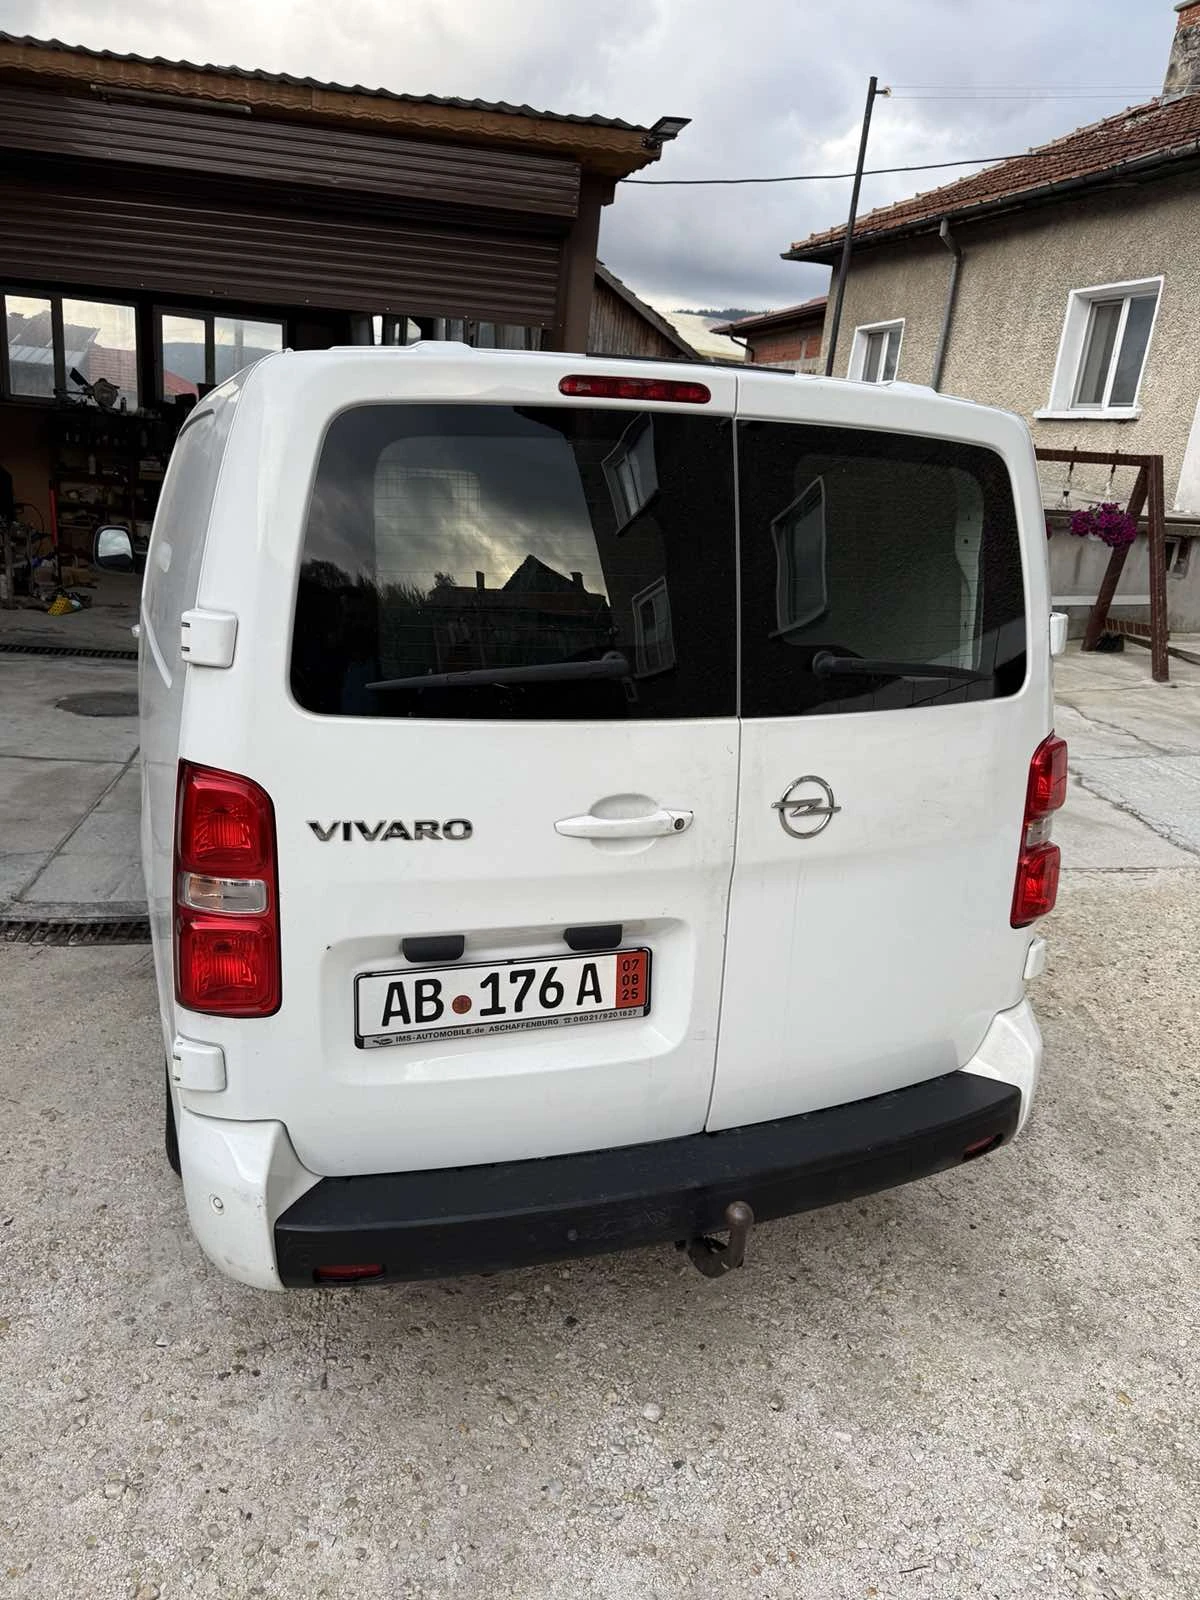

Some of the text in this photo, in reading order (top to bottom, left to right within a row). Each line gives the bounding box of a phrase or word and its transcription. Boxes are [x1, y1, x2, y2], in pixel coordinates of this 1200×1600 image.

[307, 819, 473, 842] VIVARO
[622, 959, 639, 972] 07
[622, 973, 639, 986] 08
[381, 963, 602, 1026] AB 176 A
[622, 987, 639, 1001] 25
[395, 1027, 485, 1042] IMS-AUTOMOBILE.de
[488, 1018, 559, 1033] ASCHAFFENBURG
